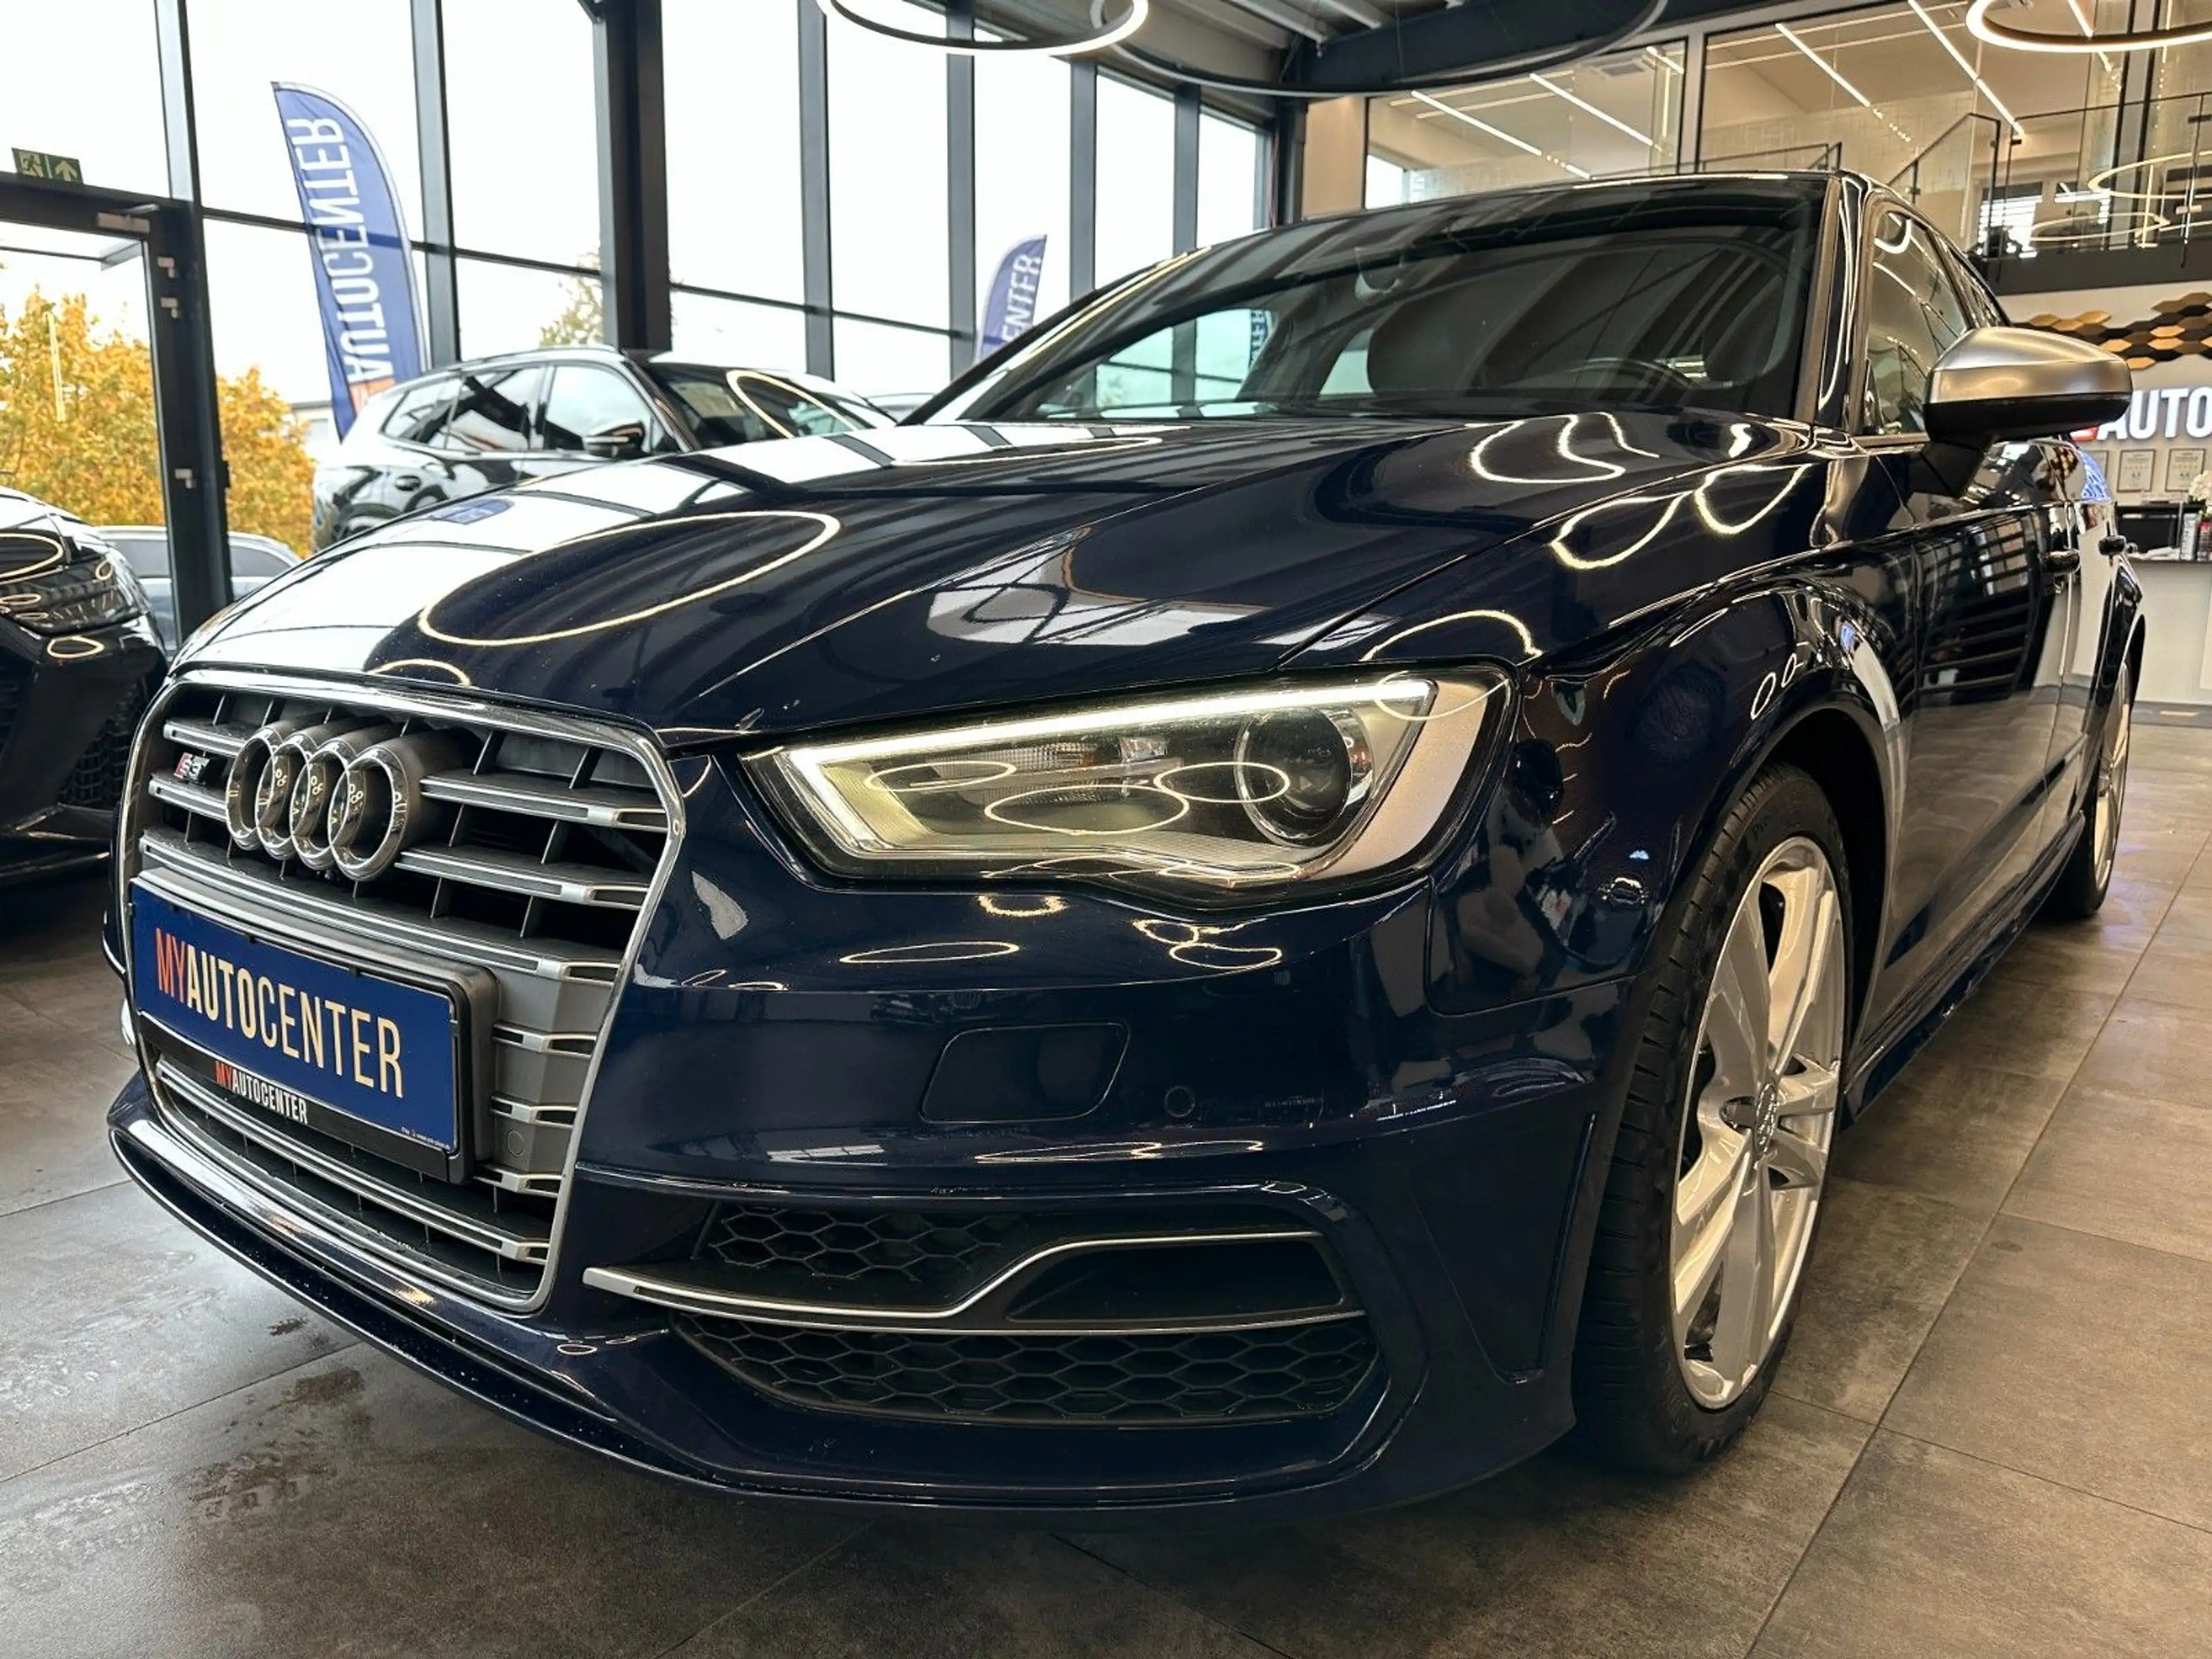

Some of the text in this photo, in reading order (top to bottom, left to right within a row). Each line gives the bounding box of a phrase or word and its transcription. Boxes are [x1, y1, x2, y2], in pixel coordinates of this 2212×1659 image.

[173, 751, 210, 781] S3
[155, 927, 403, 1099] MYAUTOCENTER
[214, 1060, 308, 1125] MYAUTOCENTER
